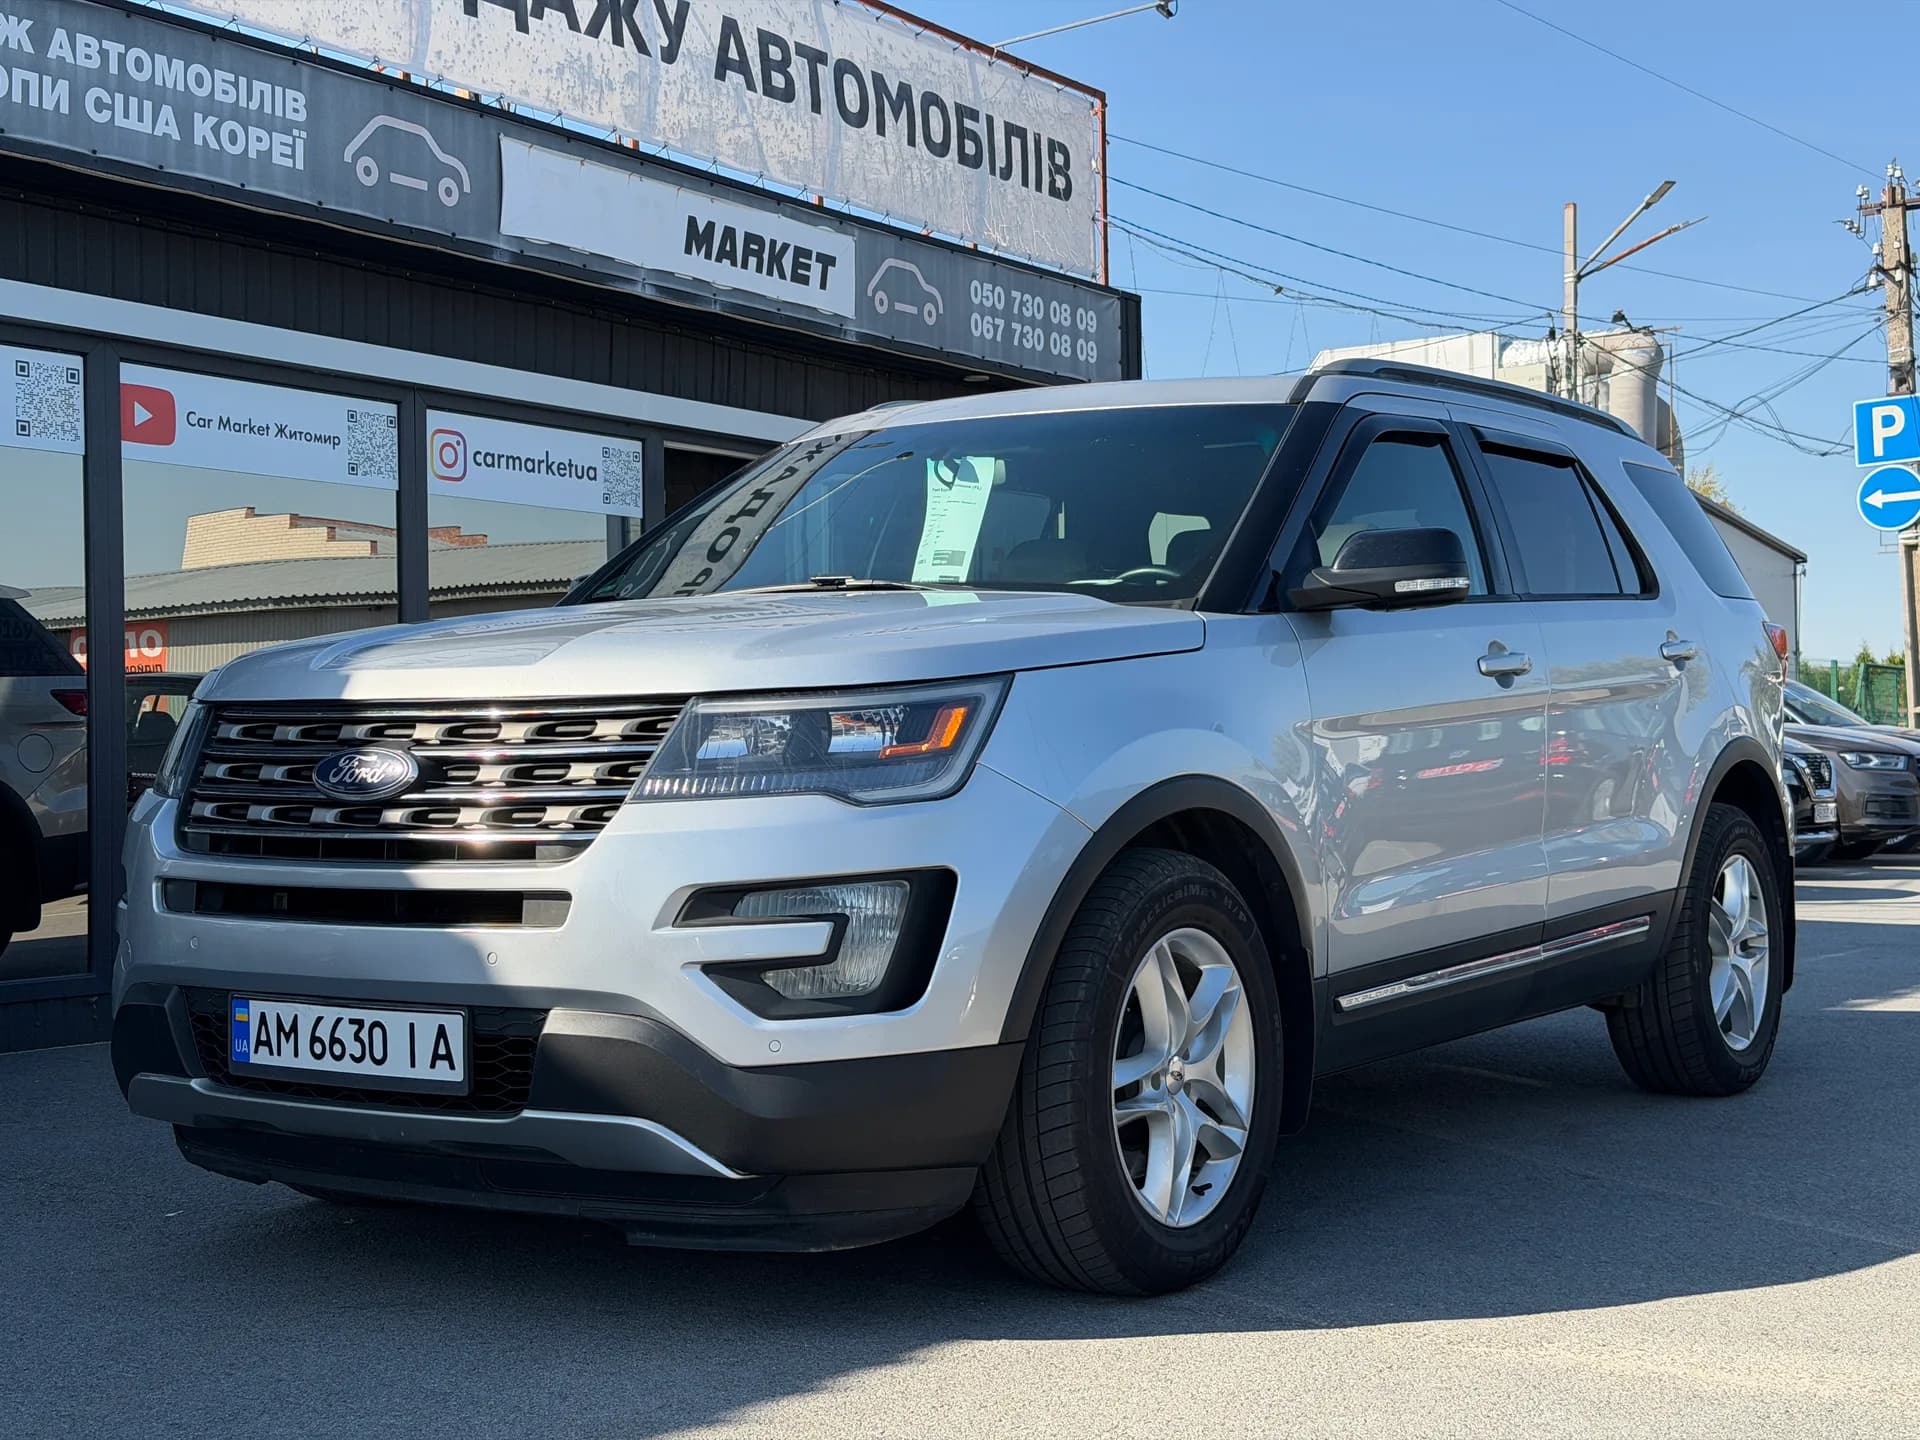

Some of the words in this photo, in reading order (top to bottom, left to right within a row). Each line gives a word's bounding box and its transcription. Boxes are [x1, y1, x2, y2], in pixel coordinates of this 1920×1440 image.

[47, 28, 308, 122] АВТОМОБІЛІВ
[84, 86, 181, 141] США
[194, 112, 307, 171] КОРЕЇ
[714, 15, 1073, 202] АВТОМОБІЛІВ
[684, 215, 837, 291] MARKET
[970, 279, 1005, 310] 050
[1011, 290, 1044, 320] 730
[1050, 301, 1071, 327] 08
[1076, 307, 1097, 333] 09
[970, 312, 1005, 342] 067
[1011, 322, 1044, 351] 730
[1050, 332, 1071, 358] 08
[1076, 338, 1097, 364] 09
[186, 411, 214, 429] Car
[217, 415, 271, 437] Market
[274, 422, 341, 450] Житомир
[1872, 405, 1905, 457] P
[473, 450, 598, 481] carmarketua
[328, 754, 386, 784] Ford
[235, 1039, 249, 1053] UA
[254, 1011, 299, 1058] AM
[309, 1015, 388, 1066] 6630
